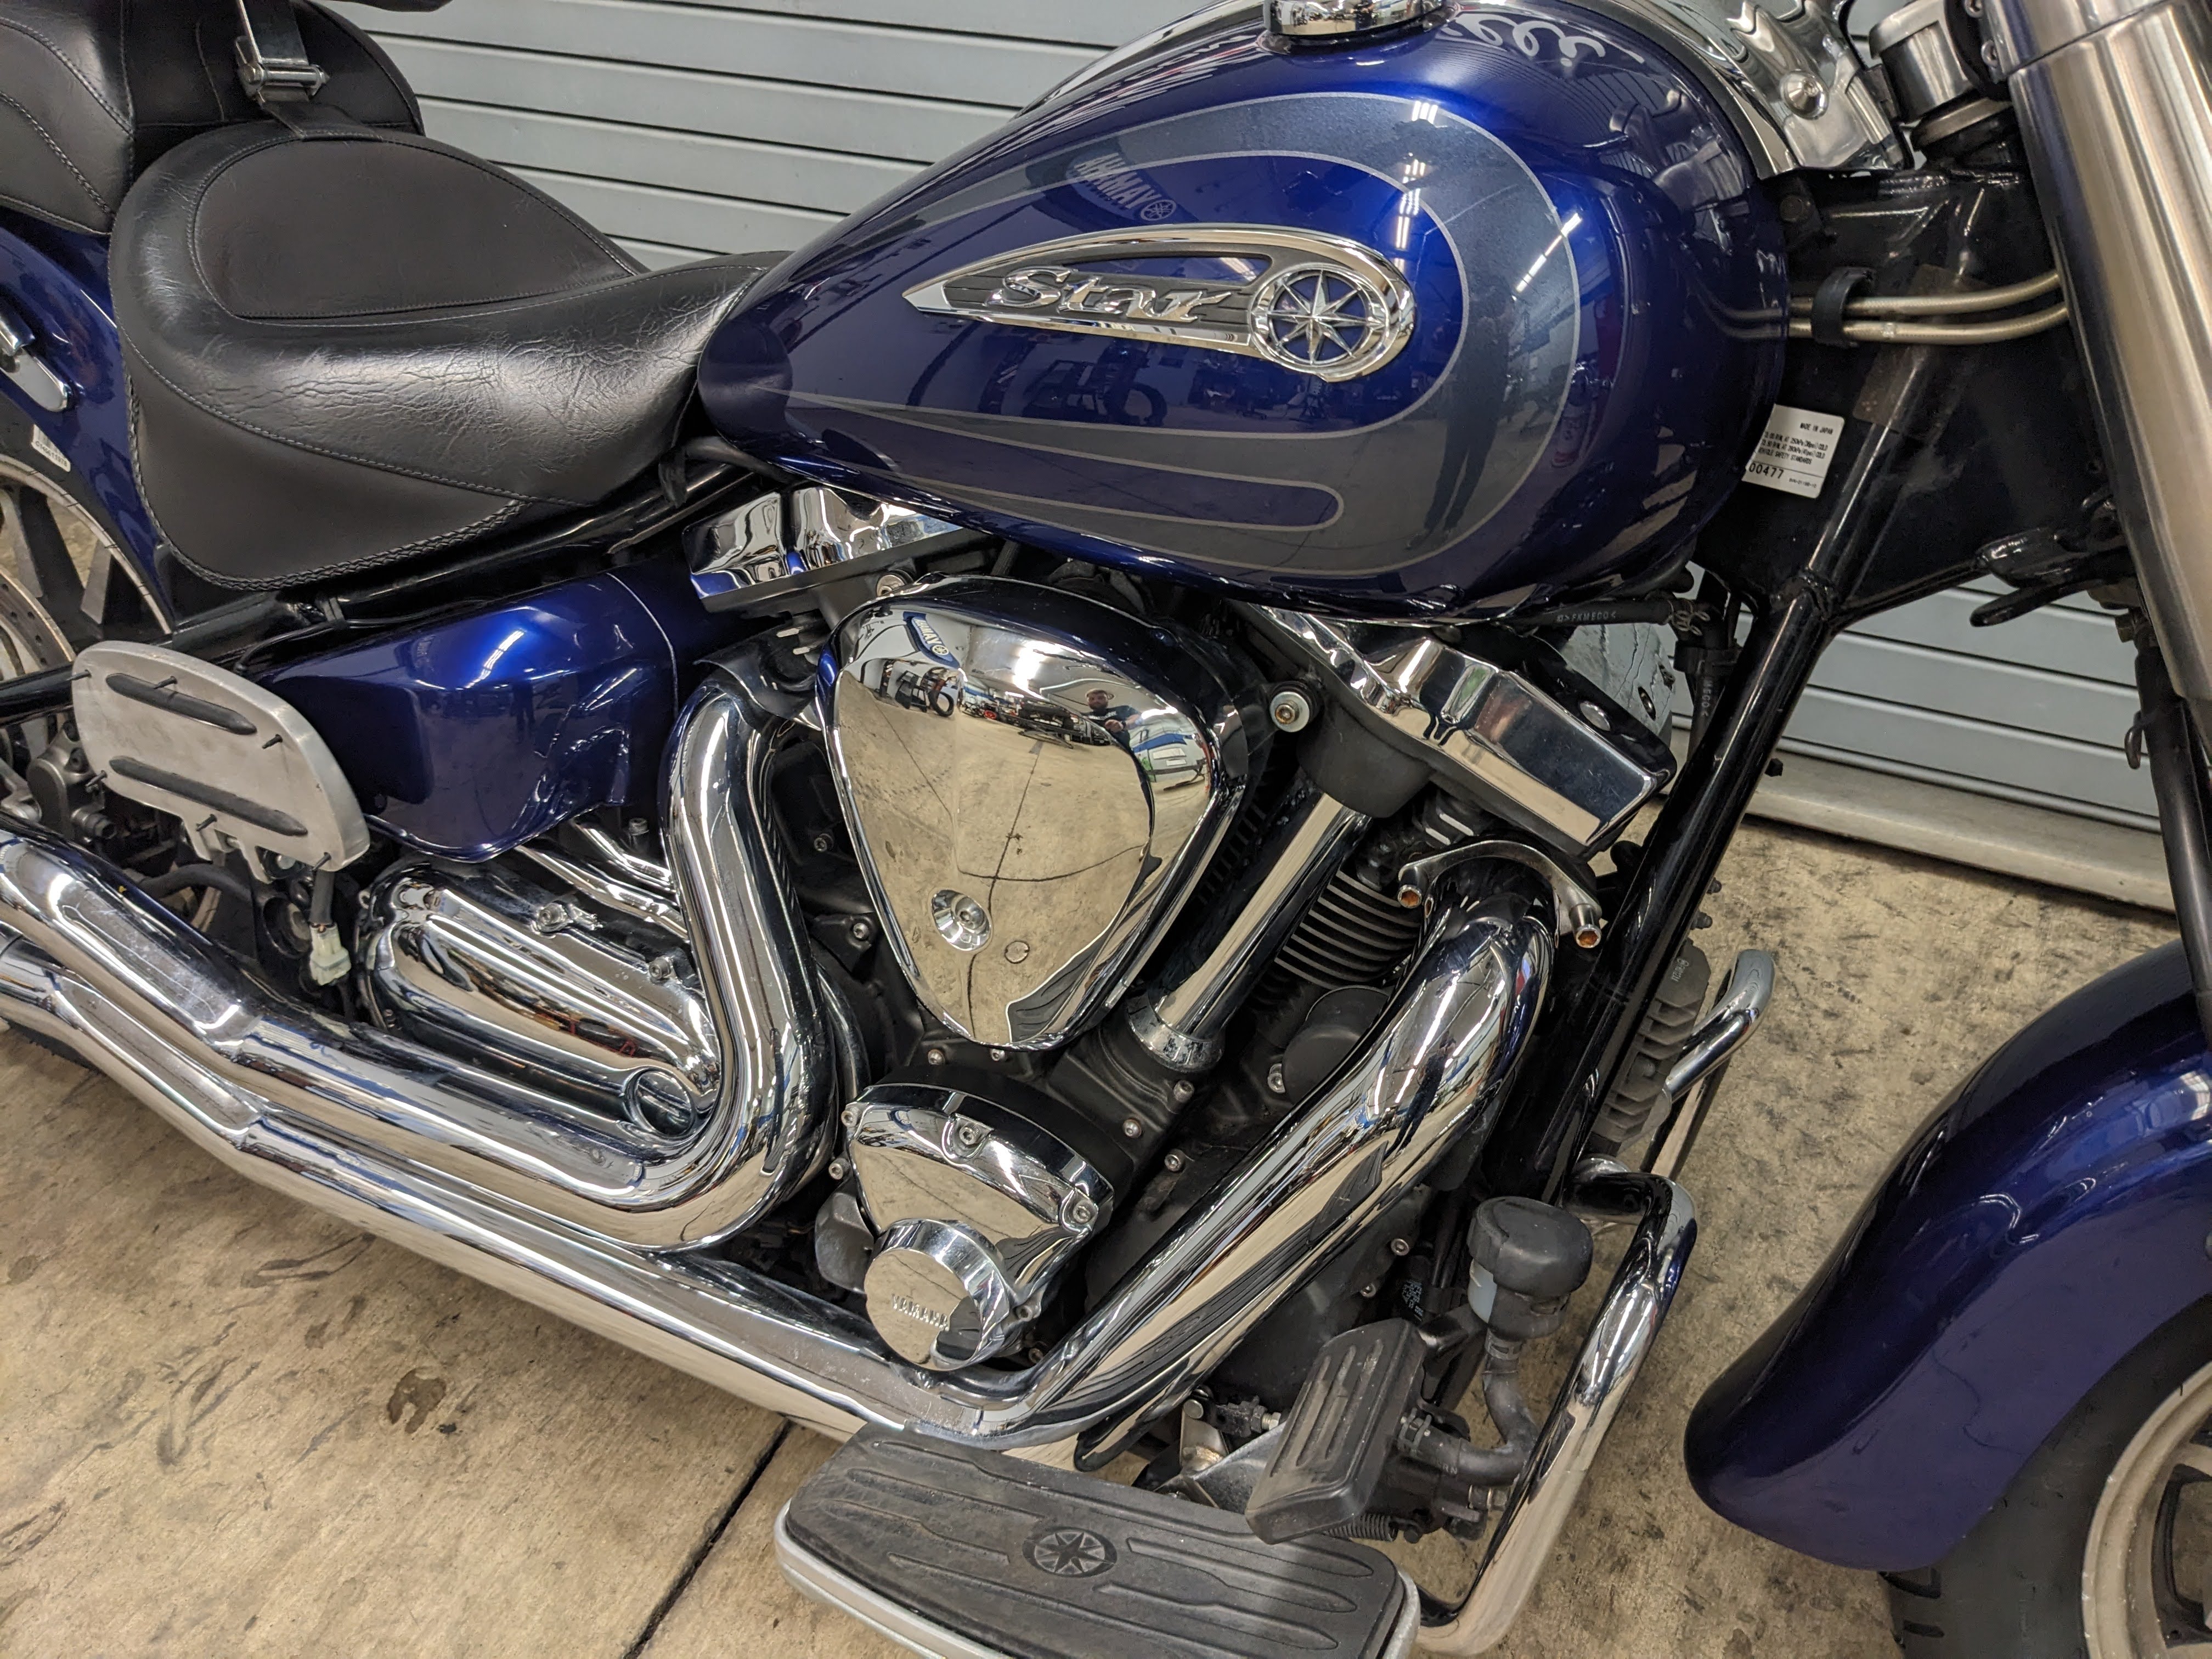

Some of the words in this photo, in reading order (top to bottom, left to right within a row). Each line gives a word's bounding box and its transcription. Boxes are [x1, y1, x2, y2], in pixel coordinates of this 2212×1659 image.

[984, 265, 1232, 323] Star
[1820, 426, 1833, 435] JAPAN
[1749, 462, 1785, 479] 00477
[891, 1293, 950, 1332] YAMAHA
